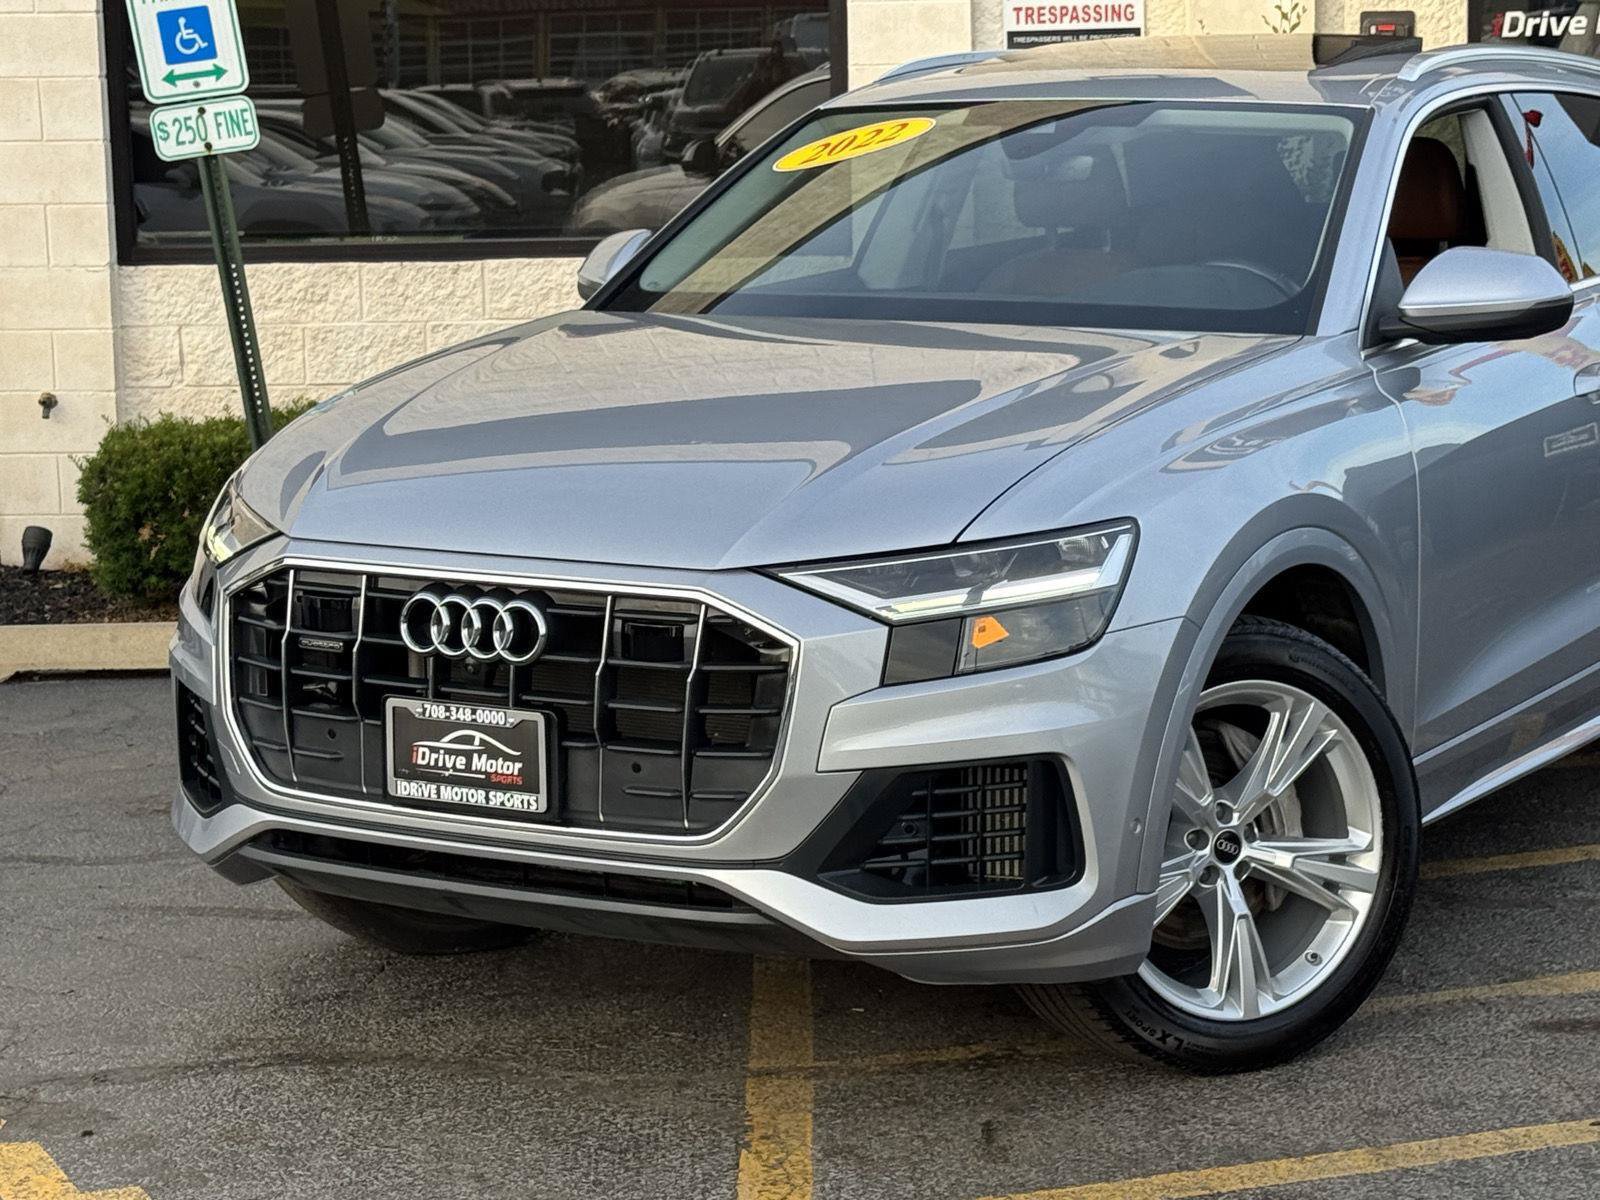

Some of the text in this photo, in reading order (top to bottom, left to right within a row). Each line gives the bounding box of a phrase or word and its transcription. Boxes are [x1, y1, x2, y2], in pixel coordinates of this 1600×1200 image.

[1012, 3, 1136, 26] TRESPASSING
[214, 108, 254, 140] FINE
[798, 121, 910, 165] 2022
[423, 704, 507, 726] 708-348-0000
[410, 746, 523, 776] iDrive Motor
[489, 773, 524, 786] SPORTS
[439, 785, 486, 805] MOTOR
[488, 791, 538, 811] SPORTS
[1125, 1006, 1157, 1037] SPORT
[1156, 1028, 1185, 1051] LX
